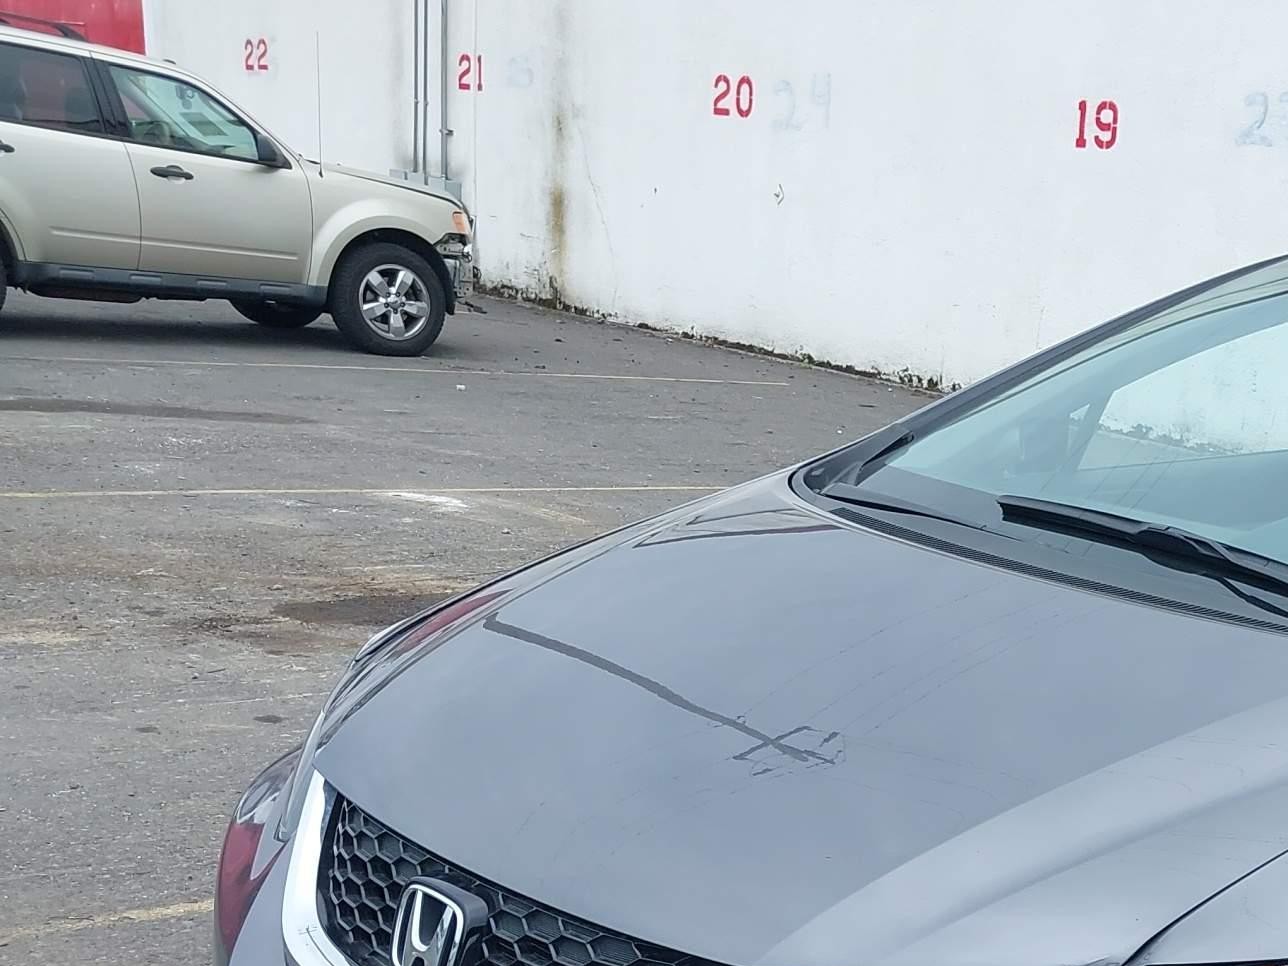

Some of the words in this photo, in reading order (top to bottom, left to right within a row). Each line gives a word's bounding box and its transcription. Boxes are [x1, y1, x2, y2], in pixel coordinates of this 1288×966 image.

[244, 38, 268, 71] 22
[457, 53, 484, 92] 21
[712, 73, 754, 118] 20
[1074, 99, 1119, 150] 19
